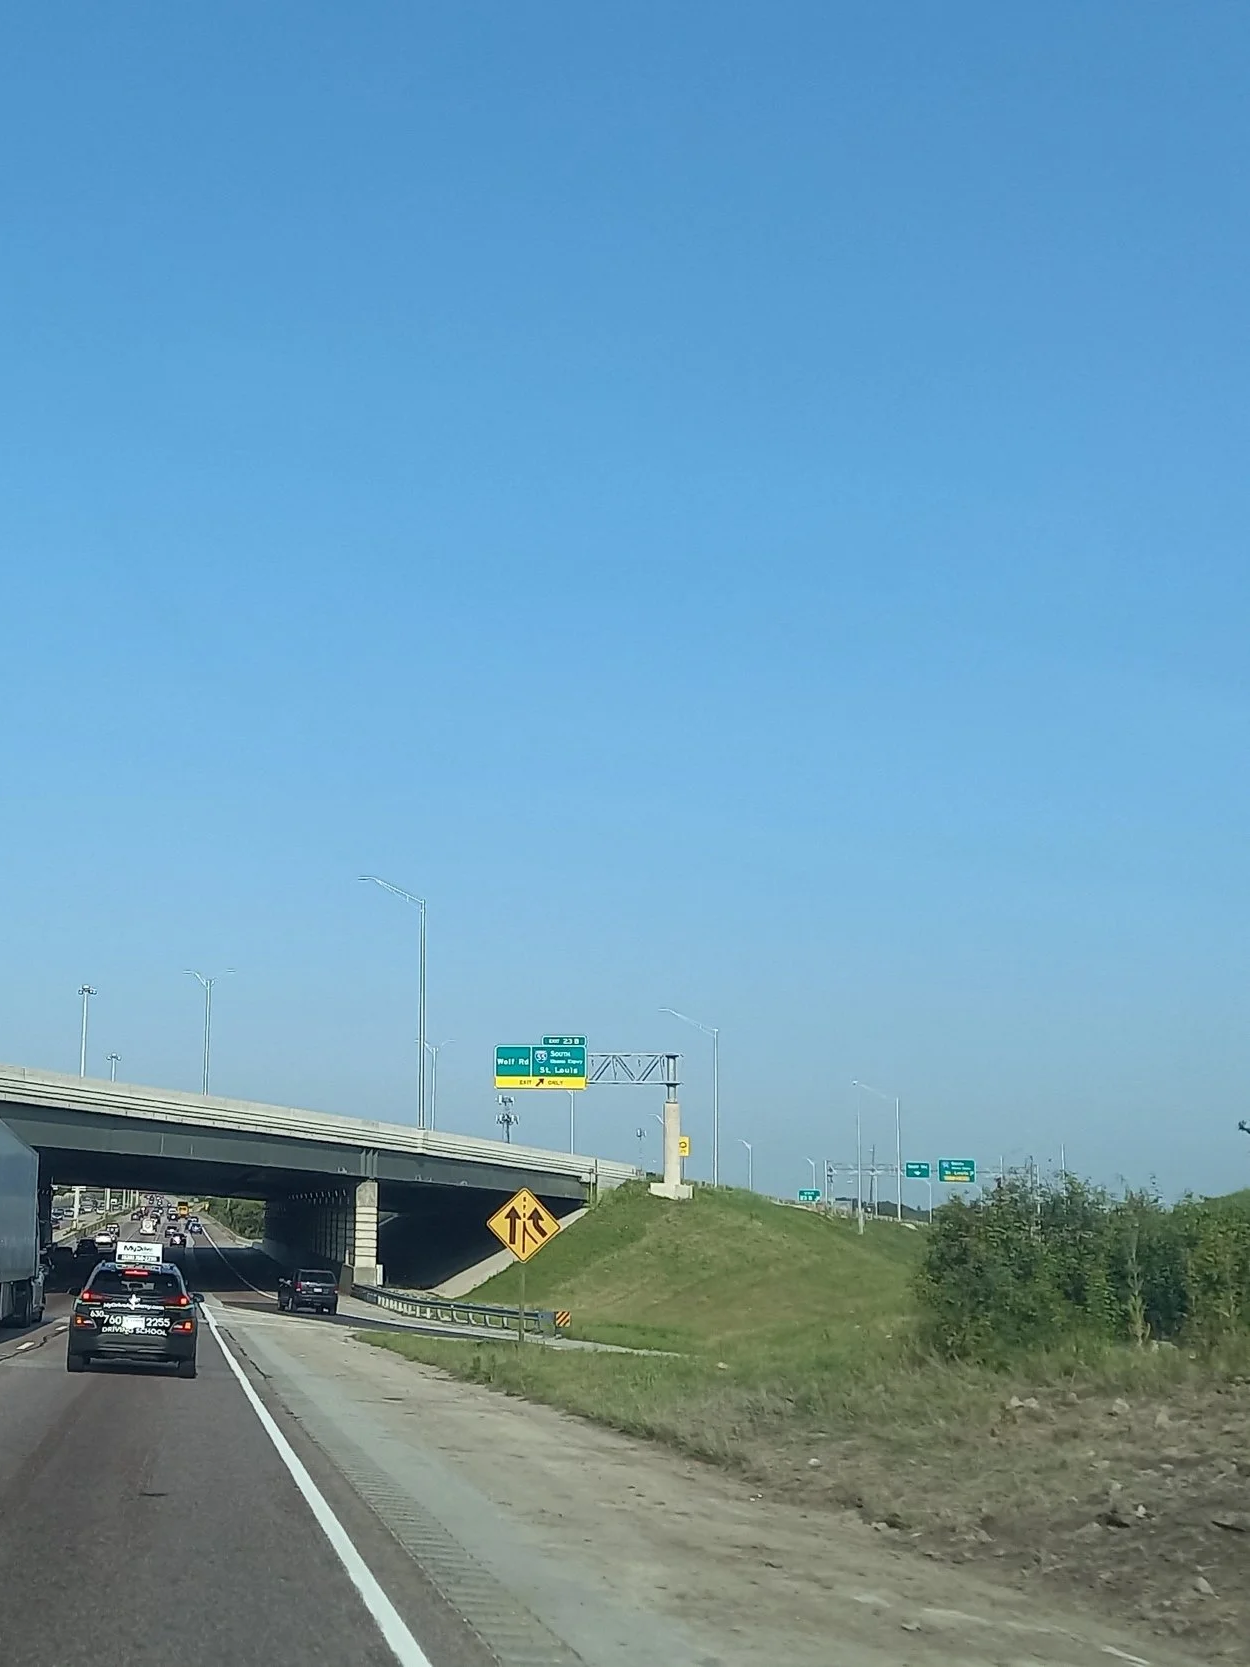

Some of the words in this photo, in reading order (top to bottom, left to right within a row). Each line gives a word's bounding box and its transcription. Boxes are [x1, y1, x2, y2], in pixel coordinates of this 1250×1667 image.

[90, 1310, 104, 1318] 630
[104, 1314, 122, 1325] 760
[146, 1317, 170, 1327] 2255
[136, 1328, 167, 1336] SCHOOL
